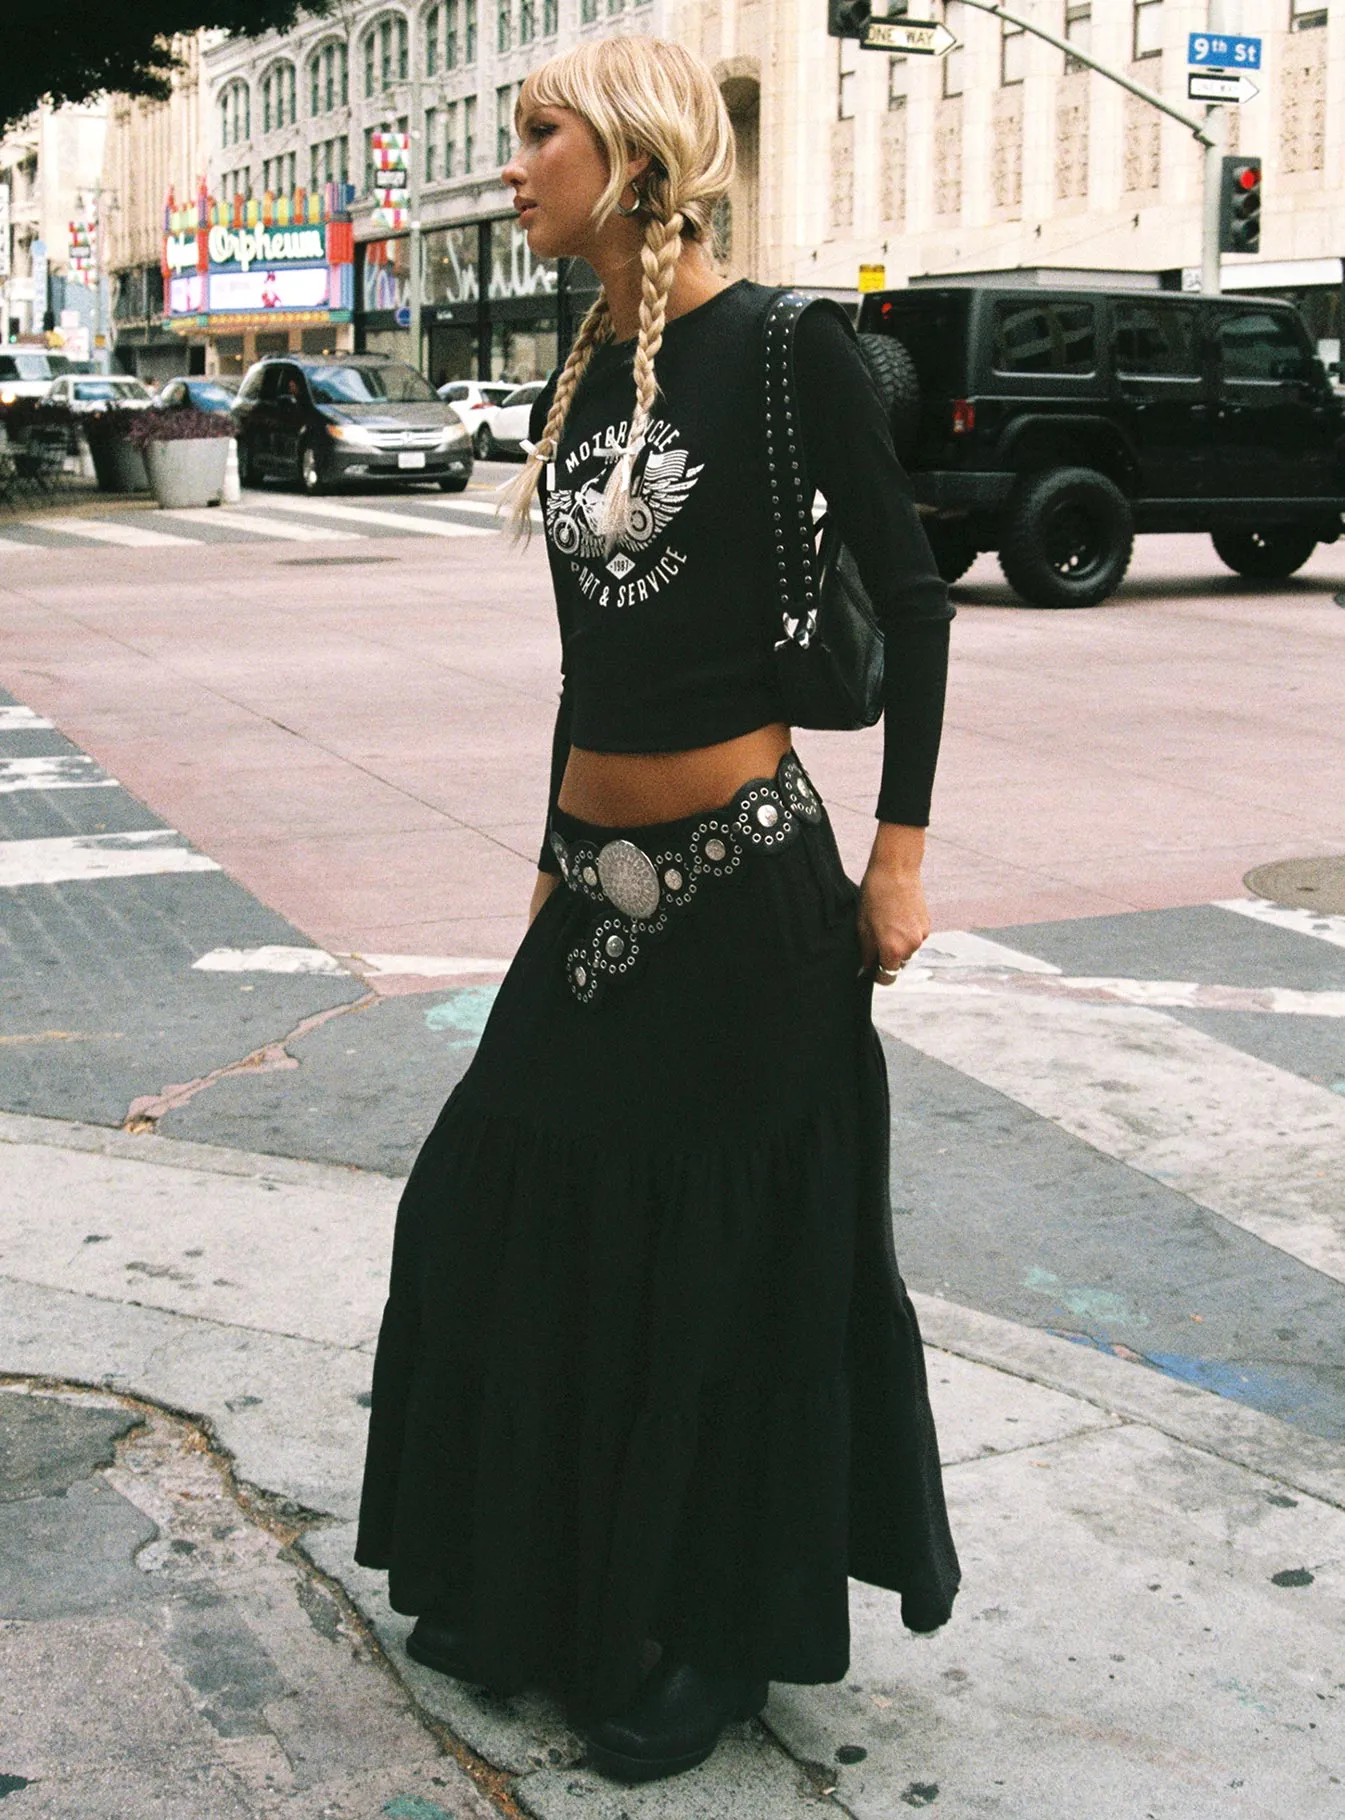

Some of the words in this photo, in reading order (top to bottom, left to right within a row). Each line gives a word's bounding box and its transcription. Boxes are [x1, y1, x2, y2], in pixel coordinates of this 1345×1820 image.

[905, 31, 935, 45] WAY
[1194, 38, 1227, 60] 9th
[1234, 43, 1256, 62] St
[209, 221, 323, 272] Orpheum
[564, 419, 680, 474] MOTORYCLE
[570, 561, 600, 600] PART
[599, 585, 610, 607] &
[617, 546, 688, 608] SERVICE
